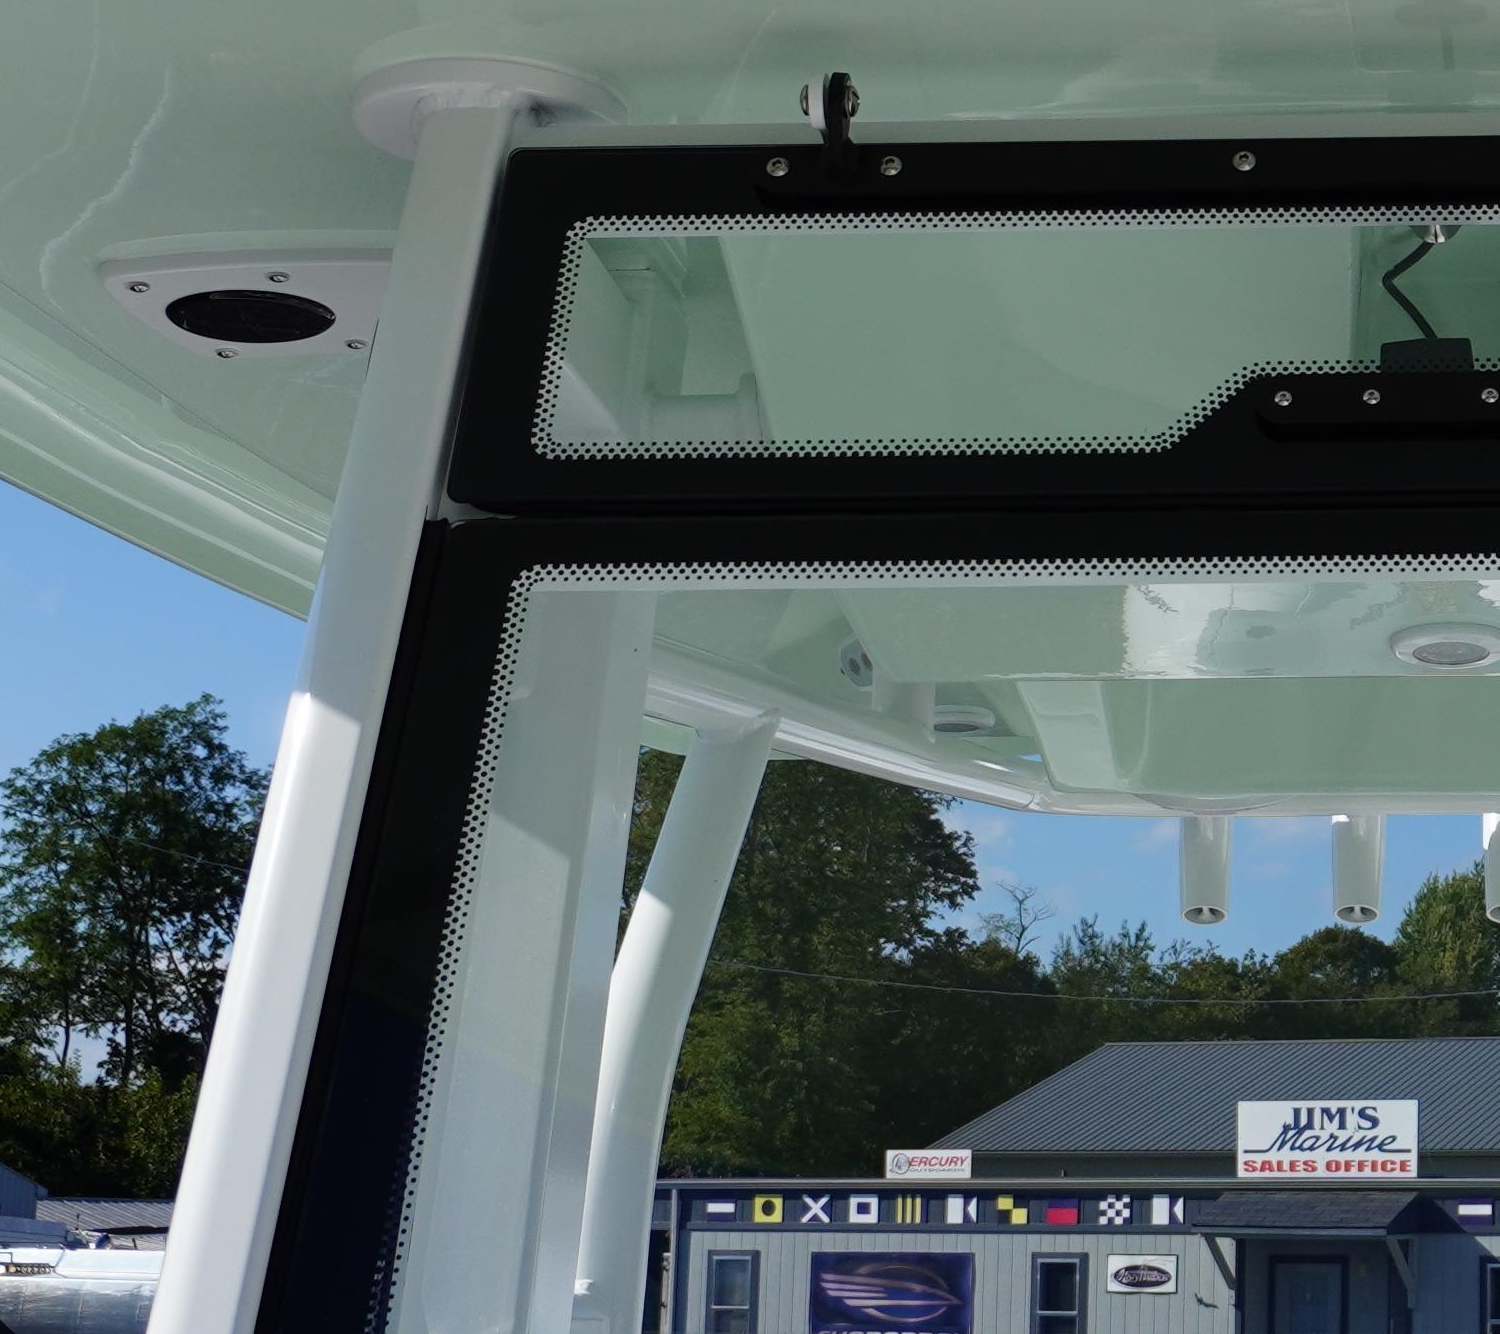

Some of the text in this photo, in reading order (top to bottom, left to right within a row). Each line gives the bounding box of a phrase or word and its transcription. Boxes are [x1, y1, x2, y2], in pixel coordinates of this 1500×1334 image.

[1291, 1106, 1381, 1131] JIM'S
[1243, 1121, 1413, 1154] Marine
[1243, 1159, 1413, 1173] SALES OFFICE
